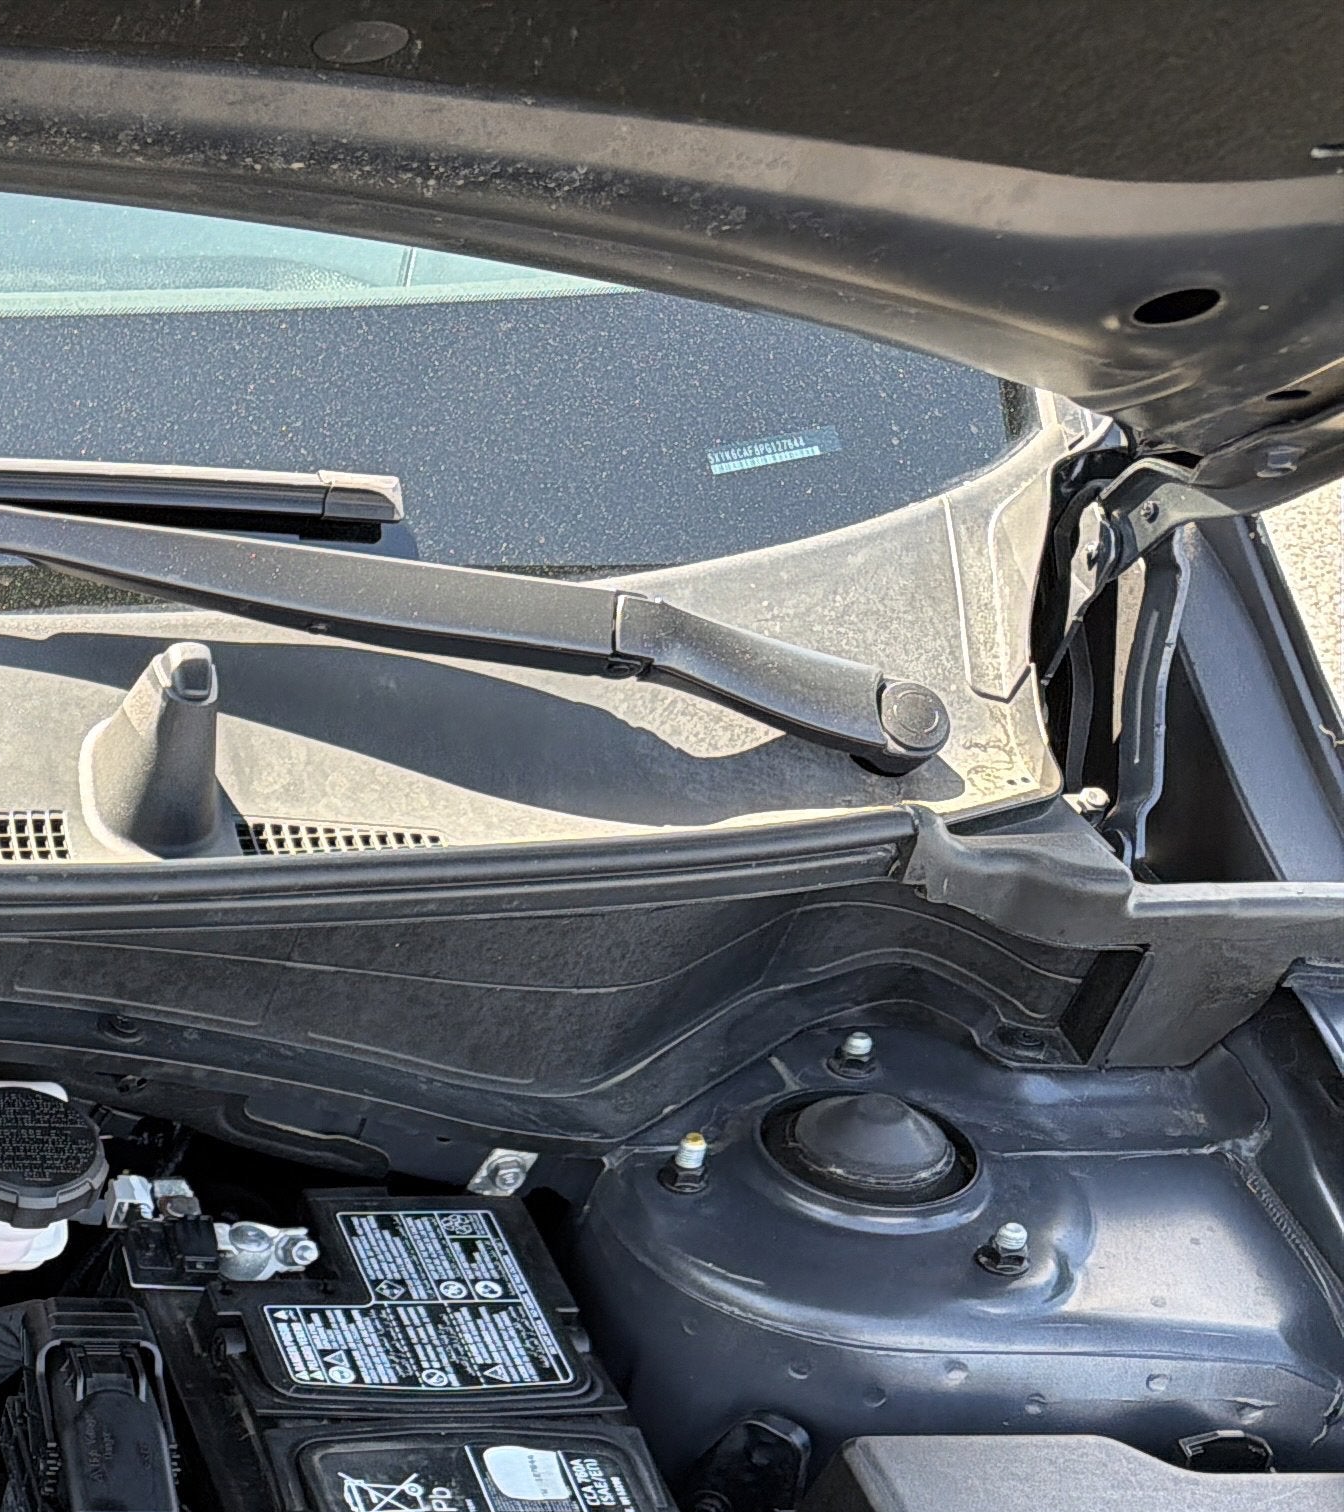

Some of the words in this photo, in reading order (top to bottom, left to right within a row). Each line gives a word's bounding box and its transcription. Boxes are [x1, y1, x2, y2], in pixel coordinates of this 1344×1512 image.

[566, 1458, 592, 1482] 760A
[431, 1487, 458, 1512] Pb
[578, 1484, 602, 1505] CCA
